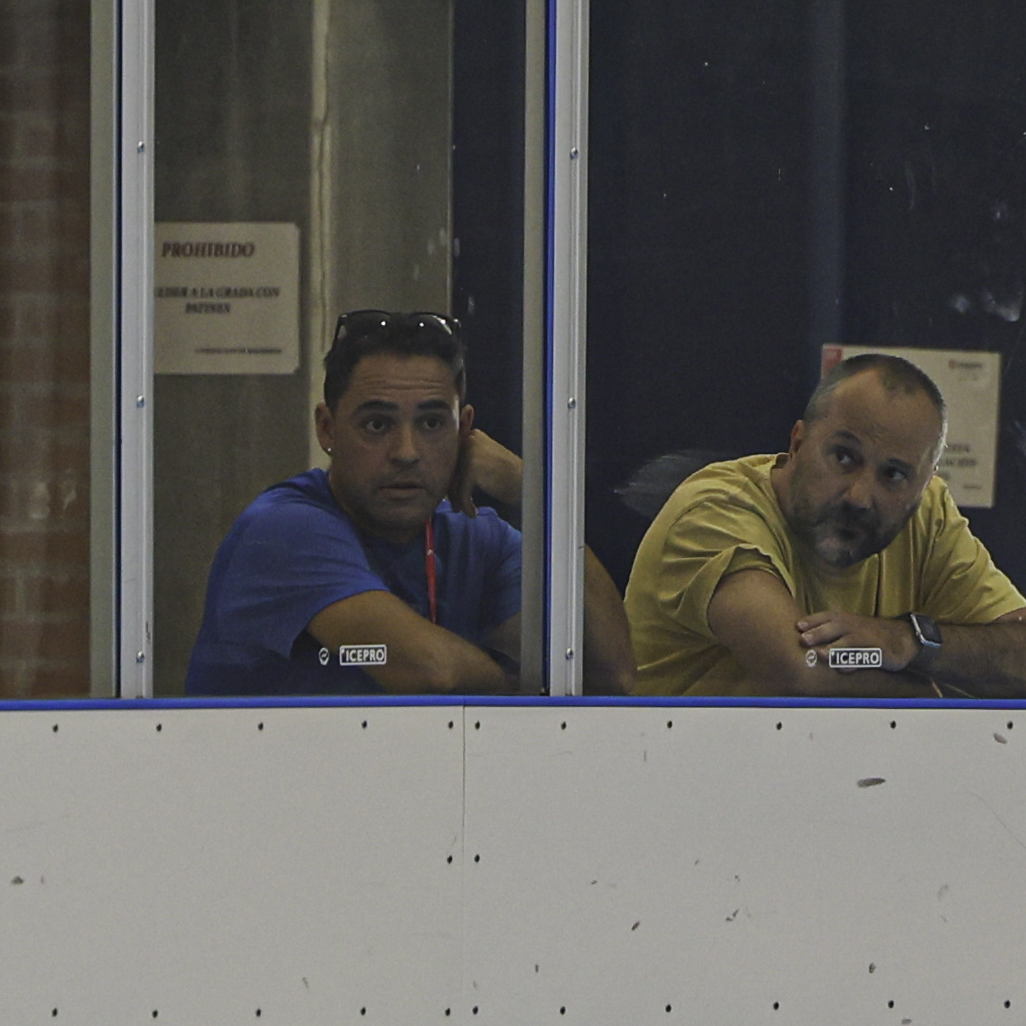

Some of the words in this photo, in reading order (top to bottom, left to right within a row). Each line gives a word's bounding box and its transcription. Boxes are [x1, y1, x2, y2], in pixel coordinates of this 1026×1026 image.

[161, 241, 256, 258] PROHIBIDO
[345, 648, 384, 662] ICEPRO
[836, 651, 880, 664] ICEPRO
